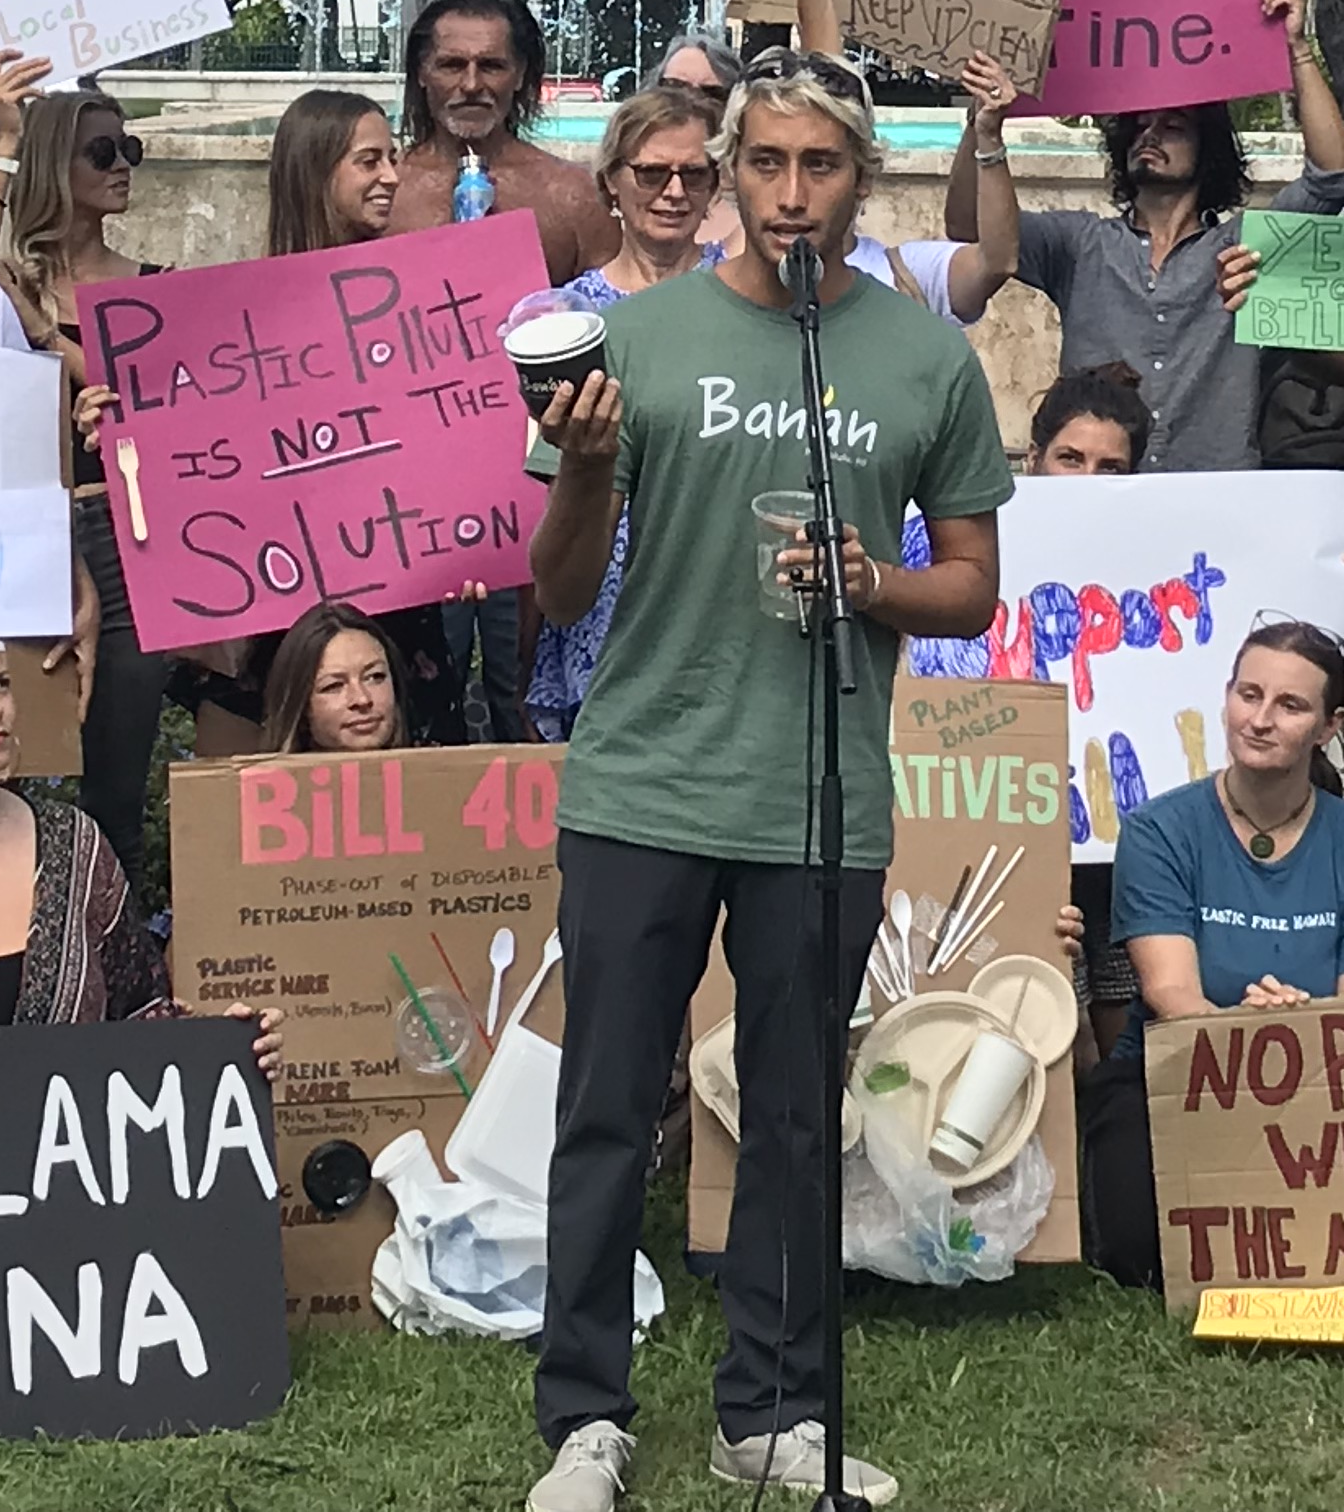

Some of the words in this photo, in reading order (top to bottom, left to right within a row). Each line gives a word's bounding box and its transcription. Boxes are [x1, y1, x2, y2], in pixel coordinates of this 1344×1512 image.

[931, 6, 967, 47] IT
[171, 439, 243, 480] IS
[271, 405, 382, 466] NOT
[407, 380, 510, 427] THE
[910, 687, 997, 727] PLANT
[938, 707, 1019, 749] BASED
[463, 756, 558, 852] 40
[280, 875, 384, 896] PHASE-OUT
[431, 864, 554, 887] DISPOSABLE
[238, 901, 412, 926] PETROLEUM-BASED
[429, 892, 531, 916] PLASTICS
[196, 954, 276, 979] PLASTIC
[350, 1056, 401, 1076] FOAM
[1184, 1023, 1304, 1112] NO
[1168, 1206, 1306, 1283] THE
